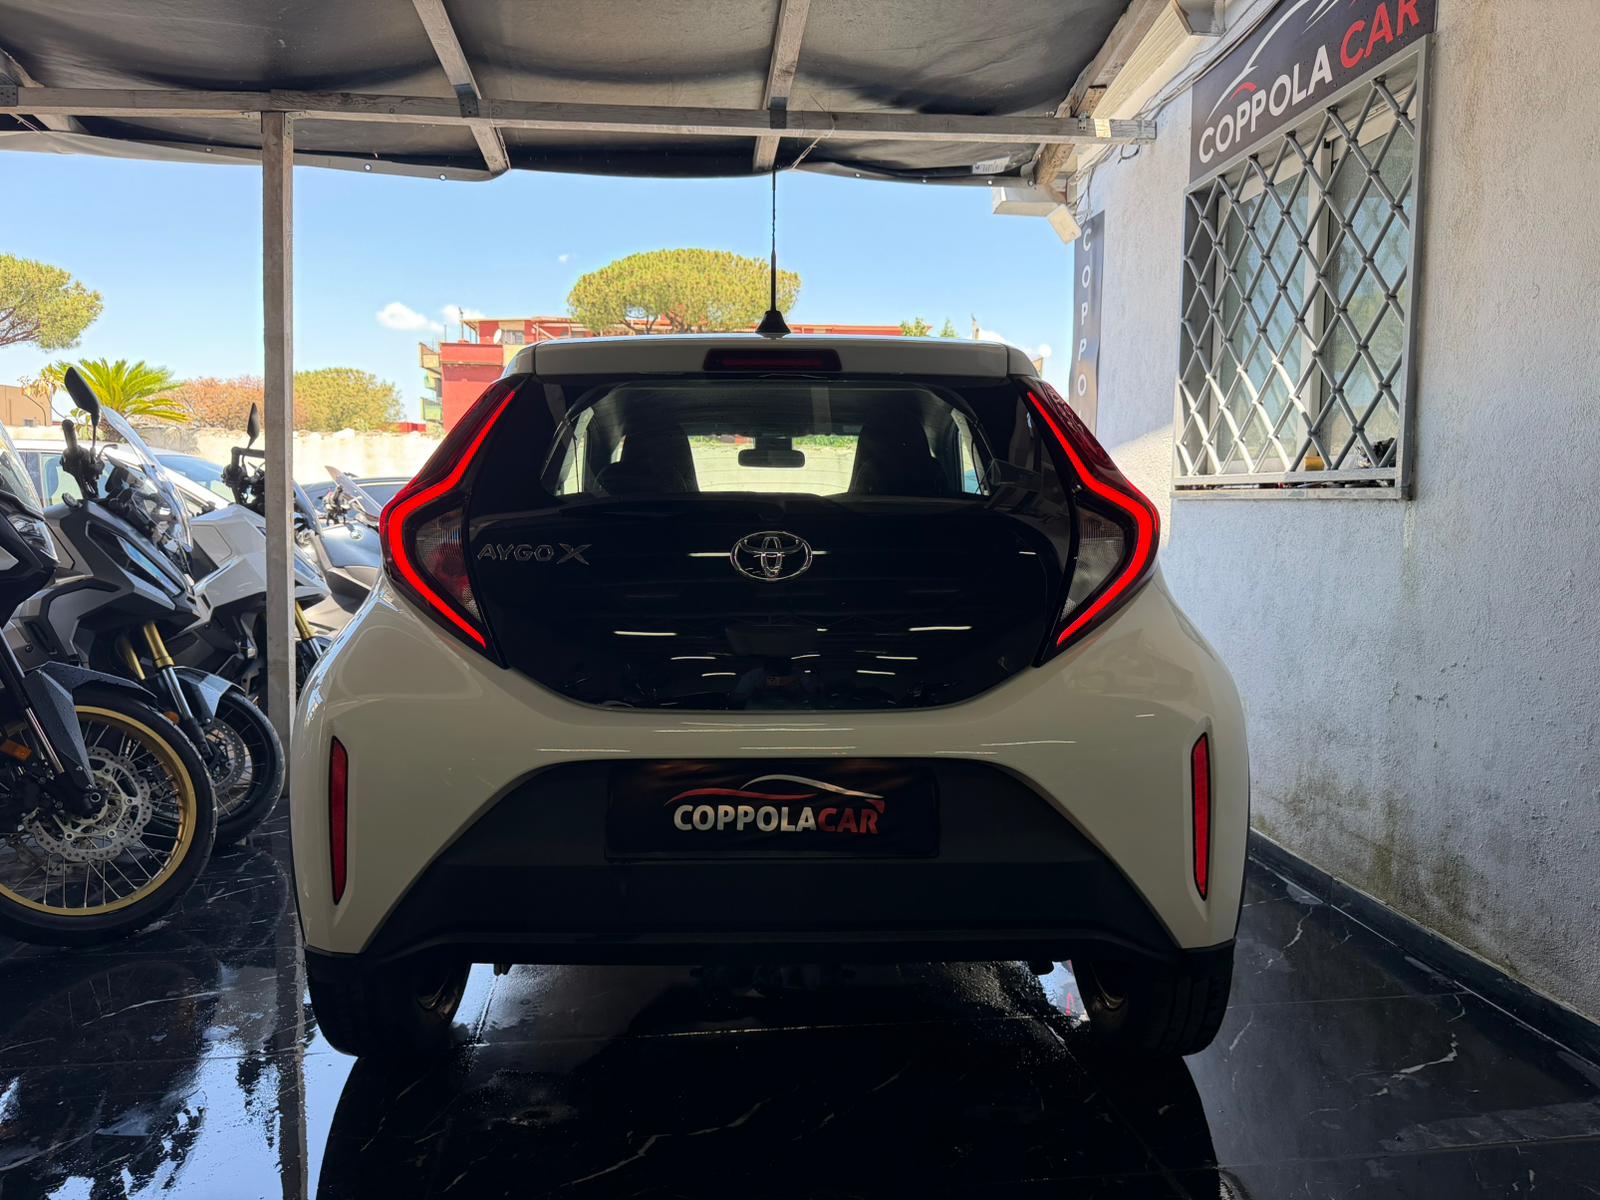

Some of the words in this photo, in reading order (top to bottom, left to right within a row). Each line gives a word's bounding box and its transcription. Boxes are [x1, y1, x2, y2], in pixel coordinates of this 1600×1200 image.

[1199, 44, 1333, 163] COPPOLA
[1340, 0, 1420, 69] CAR
[1077, 227, 1092, 421] COPPO
[477, 543, 554, 561] AYGO
